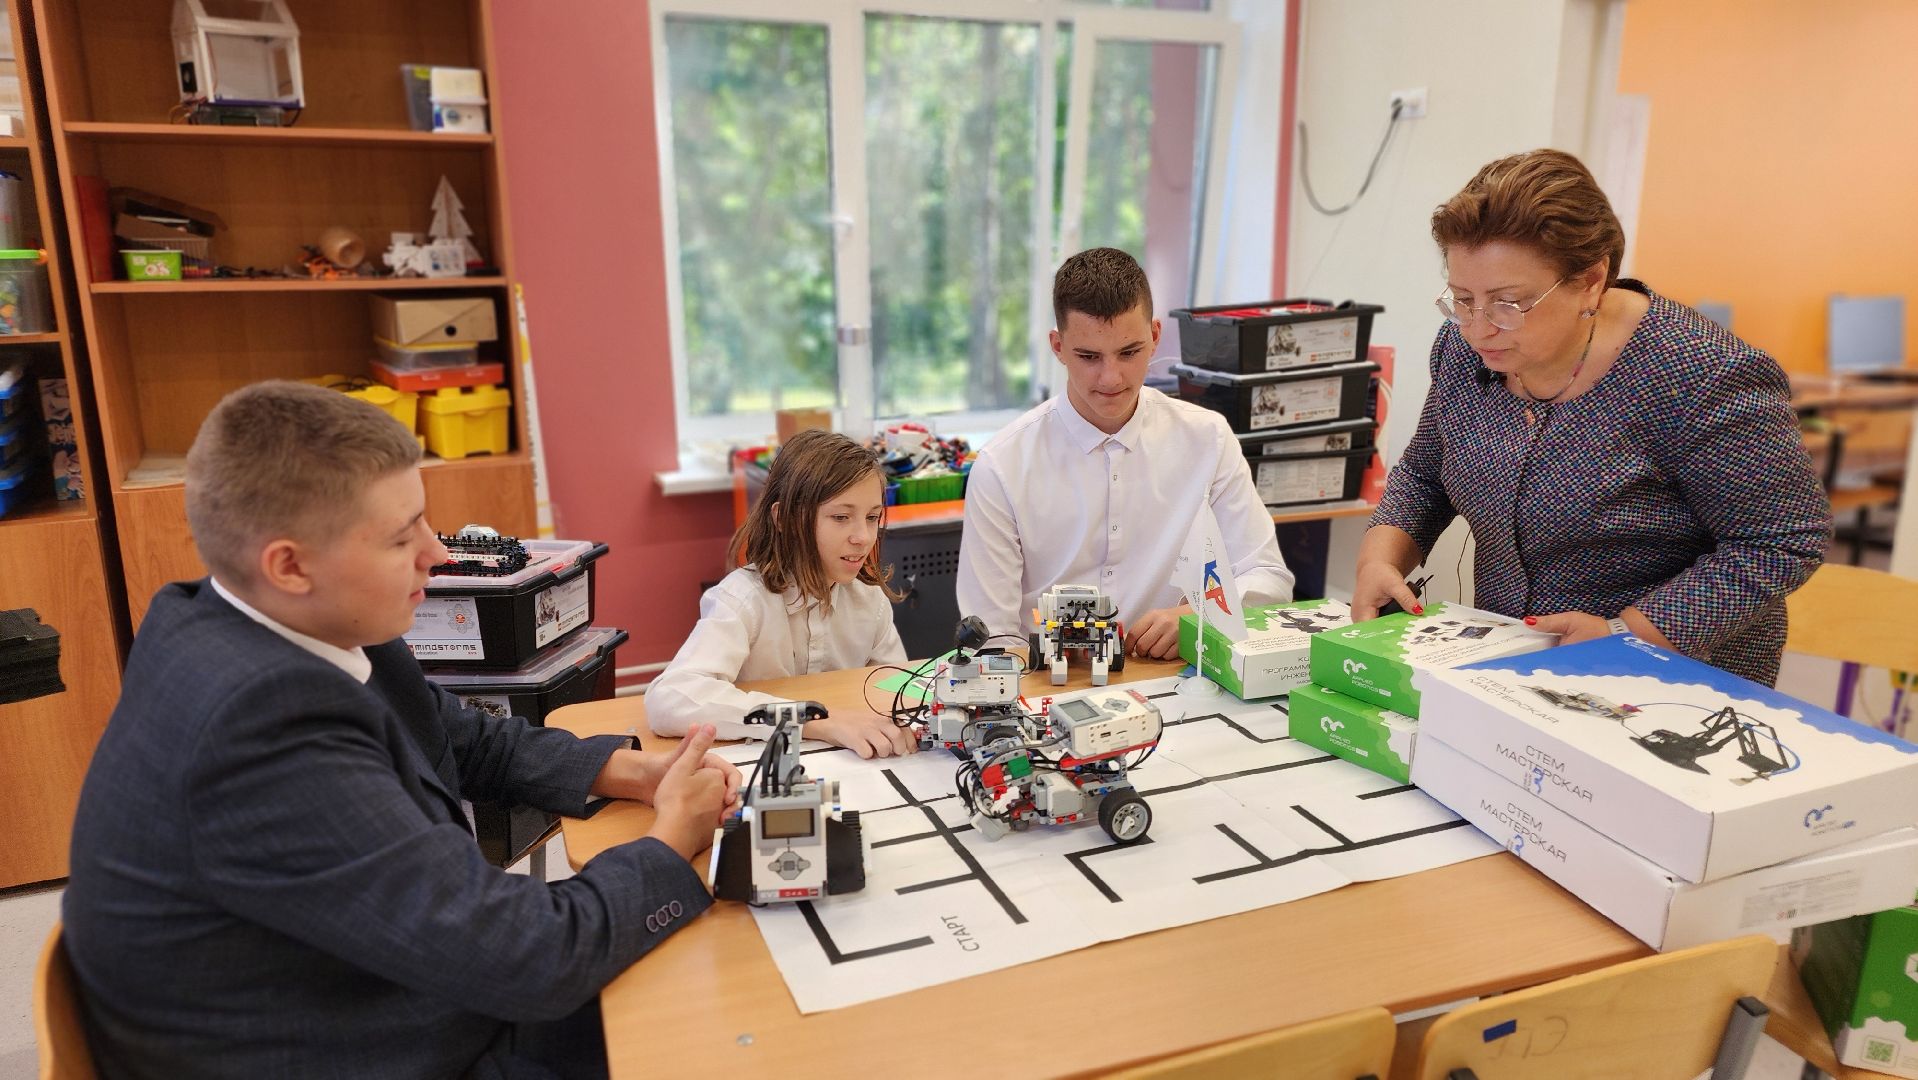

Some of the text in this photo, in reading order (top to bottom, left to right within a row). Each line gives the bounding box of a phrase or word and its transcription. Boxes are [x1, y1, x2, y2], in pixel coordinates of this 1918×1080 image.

[1465, 678, 1560, 724] МАСТЕРСКАЯ
[1525, 745, 1565, 773] СТЕМ
[1480, 799, 1568, 863] МАСТЕРСКАЯ
[1507, 802, 1543, 832] СТЕМ
[940, 915, 980, 951] СТАРТ
